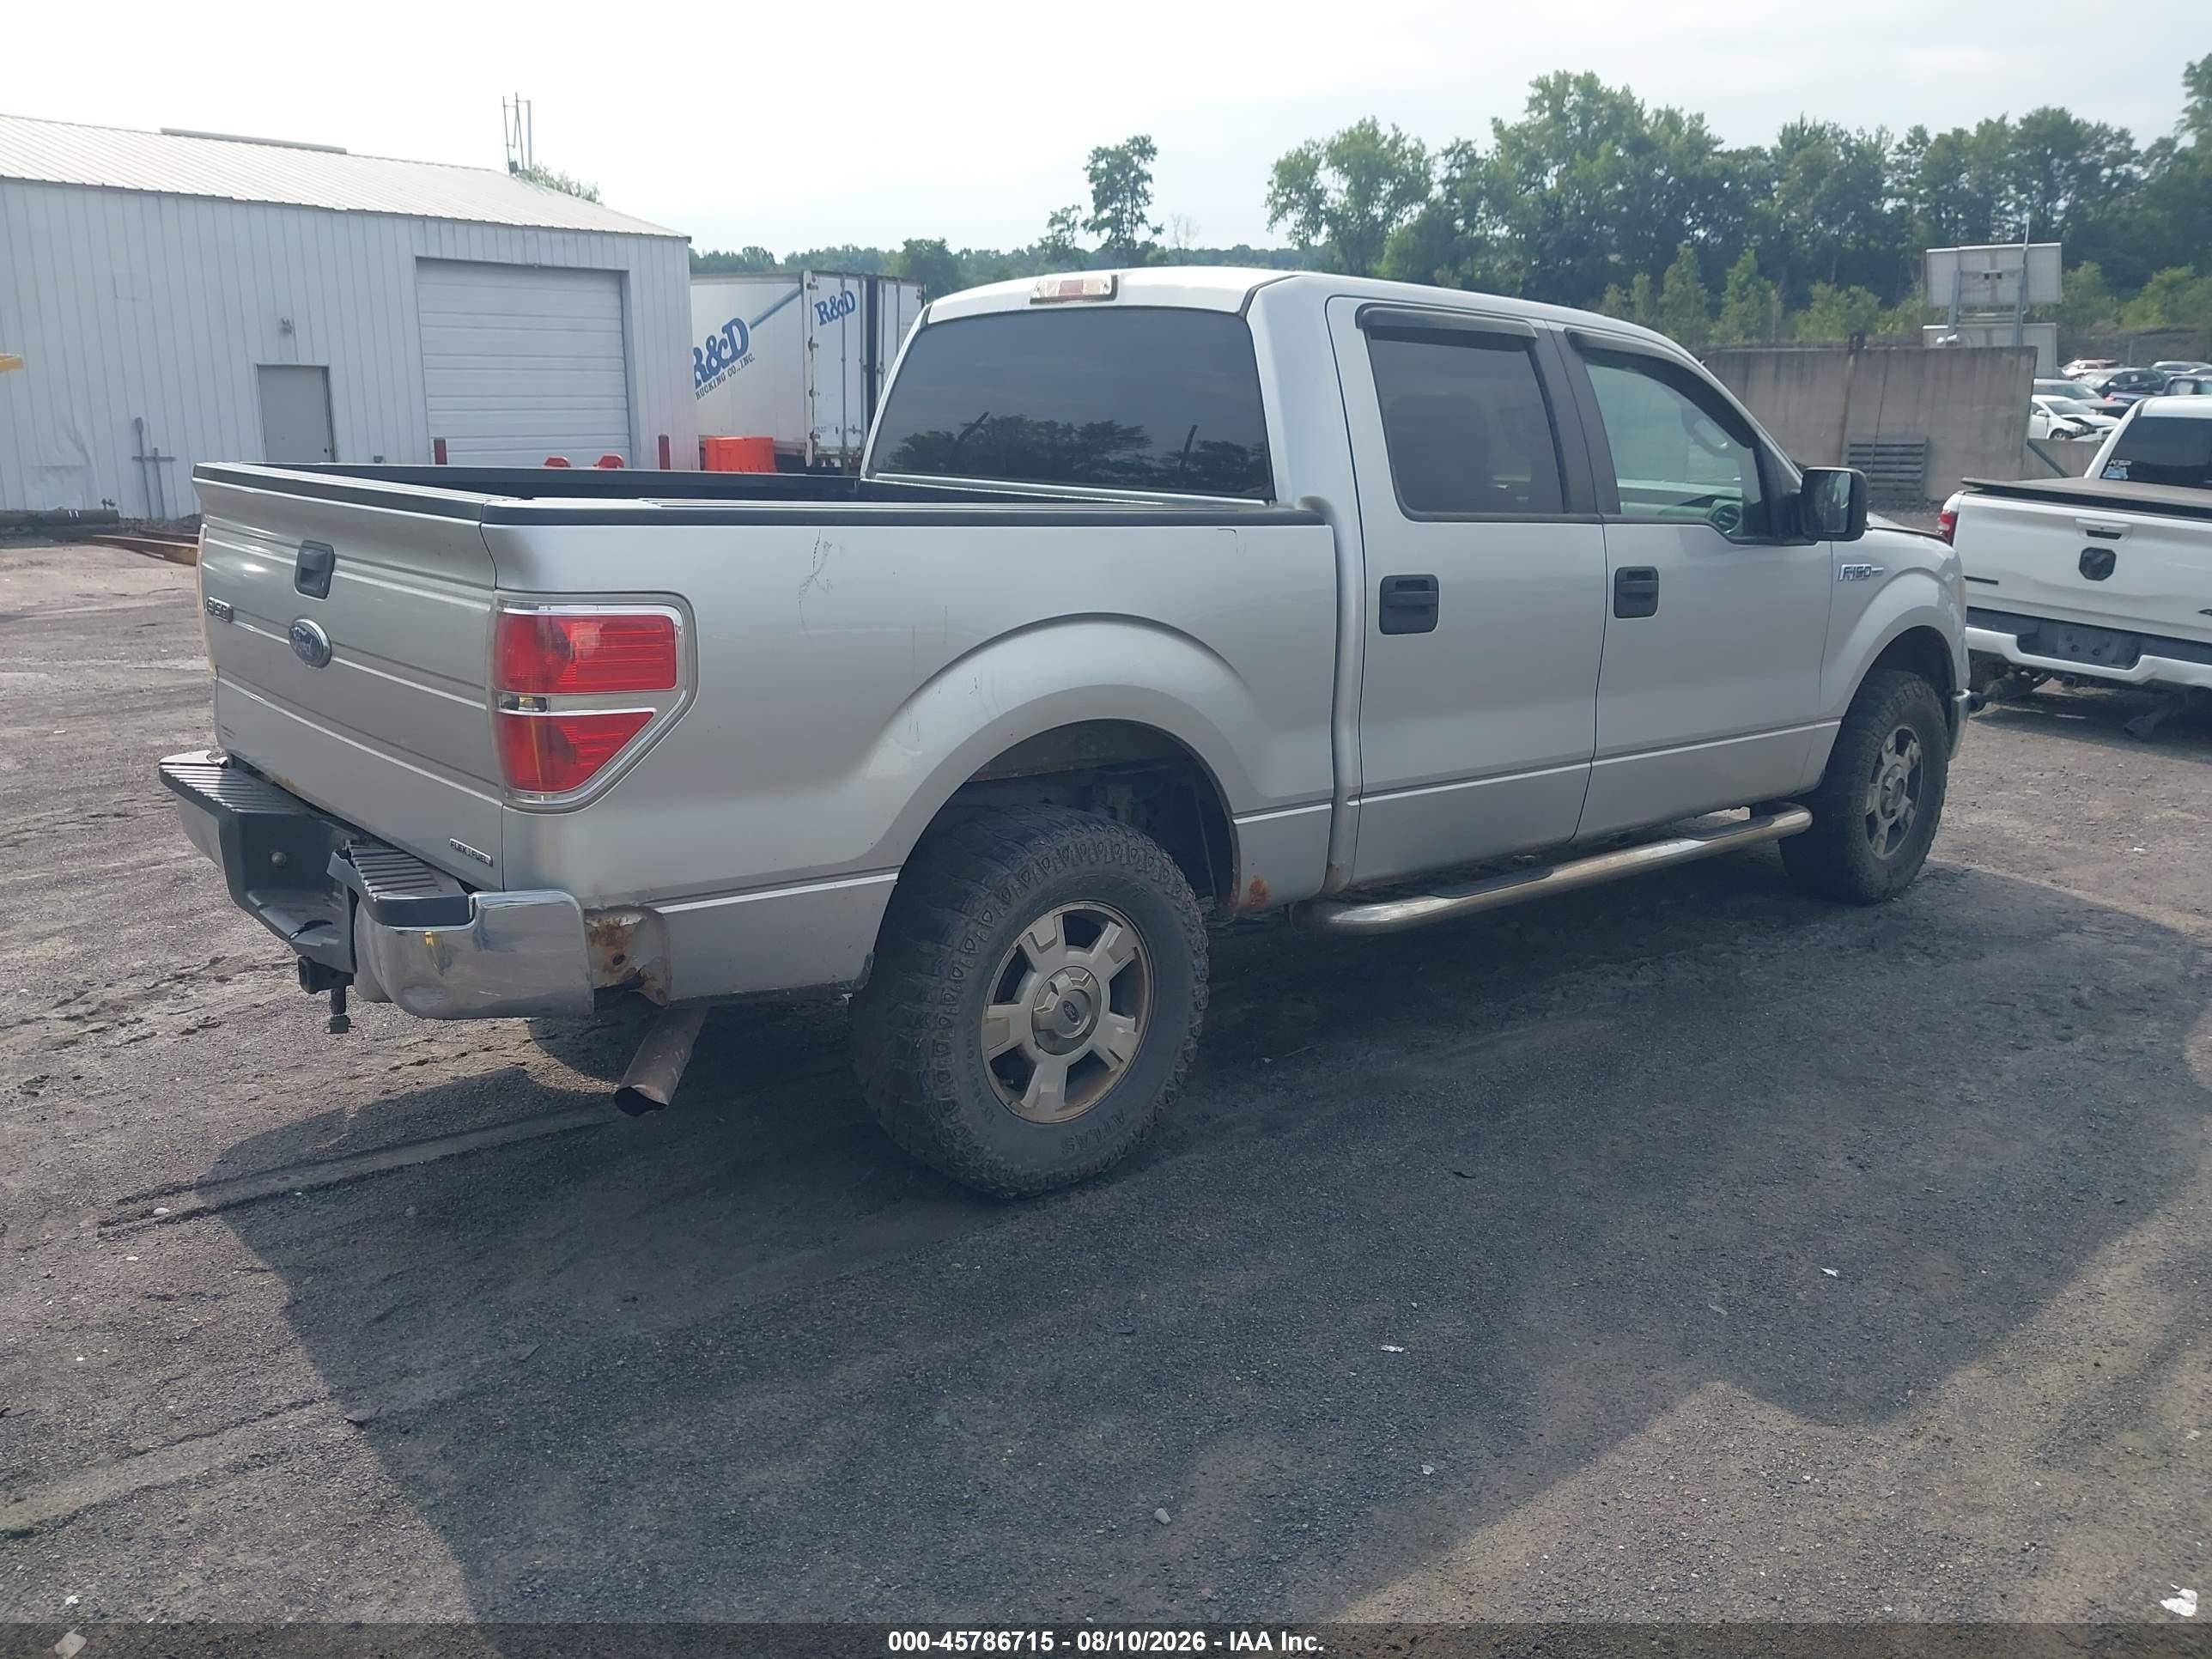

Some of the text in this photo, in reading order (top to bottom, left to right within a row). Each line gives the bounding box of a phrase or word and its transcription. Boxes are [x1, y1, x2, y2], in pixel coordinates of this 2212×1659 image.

[814, 290, 855, 326] R&D
[693, 317, 749, 389] R&D
[695, 372, 726, 401] RUCKING
